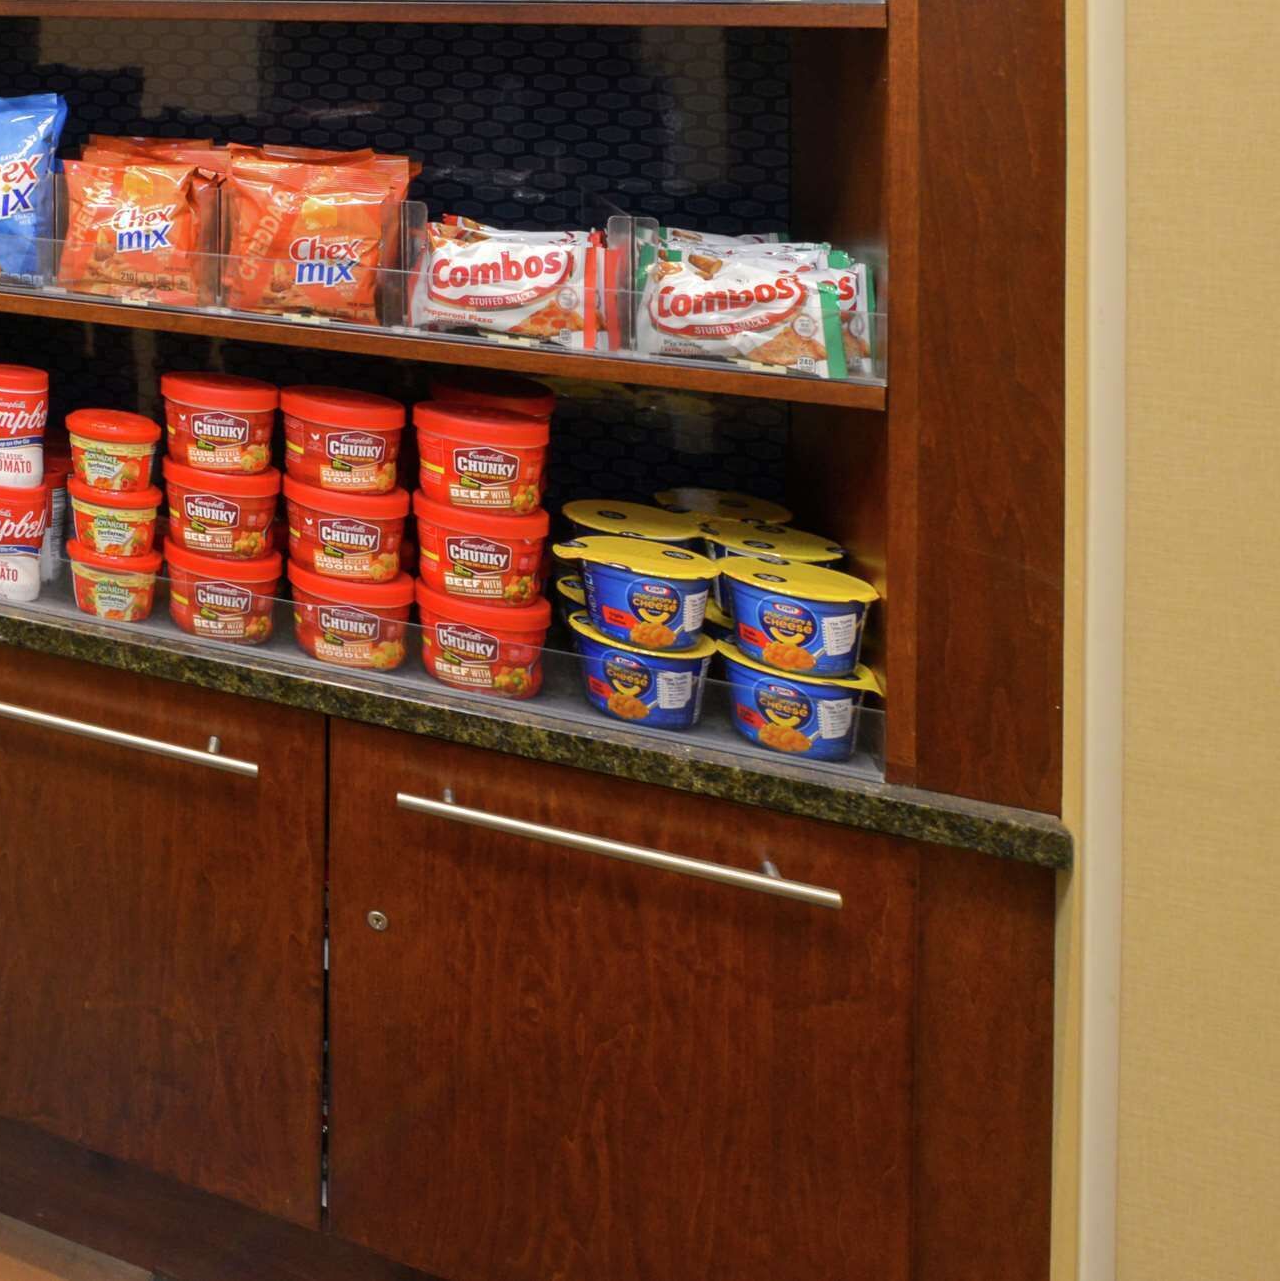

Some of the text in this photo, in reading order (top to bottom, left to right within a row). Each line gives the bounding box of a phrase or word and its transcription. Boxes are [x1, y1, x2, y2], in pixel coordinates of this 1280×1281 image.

[113, 205, 176, 230] Chex
[117, 223, 174, 252] mix
[240, 191, 290, 280] CHEDDAR
[290, 236, 362, 261] Chex
[296, 262, 356, 287] mix
[433, 251, 562, 289] Combos
[469, 291, 538, 306] STUFFED SNACKS
[658, 277, 799, 318] Combos
[694, 325, 732, 335] STUFFED
[193, 423, 244, 441] CHUNKY
[329, 441, 382, 458] CHUNKY
[457, 457, 516, 478] CHUNKY
[449, 488, 512, 499] BEEF WITH
[187, 503, 236, 523] CHUNKY
[184, 532, 212, 541] BEEF
[321, 527, 377, 548] CHUNKY
[315, 561, 369, 570] NOODLE
[449, 546, 508, 568] CHUNKY
[444, 576, 502, 589] BEEF WITH
[197, 590, 248, 609] CHUNKY
[193, 619, 224, 629] BEEF
[320, 613, 376, 636] CHUNKY
[440, 629, 495, 657] CHUNKY
[436, 662, 491, 678] BEEF WITH
